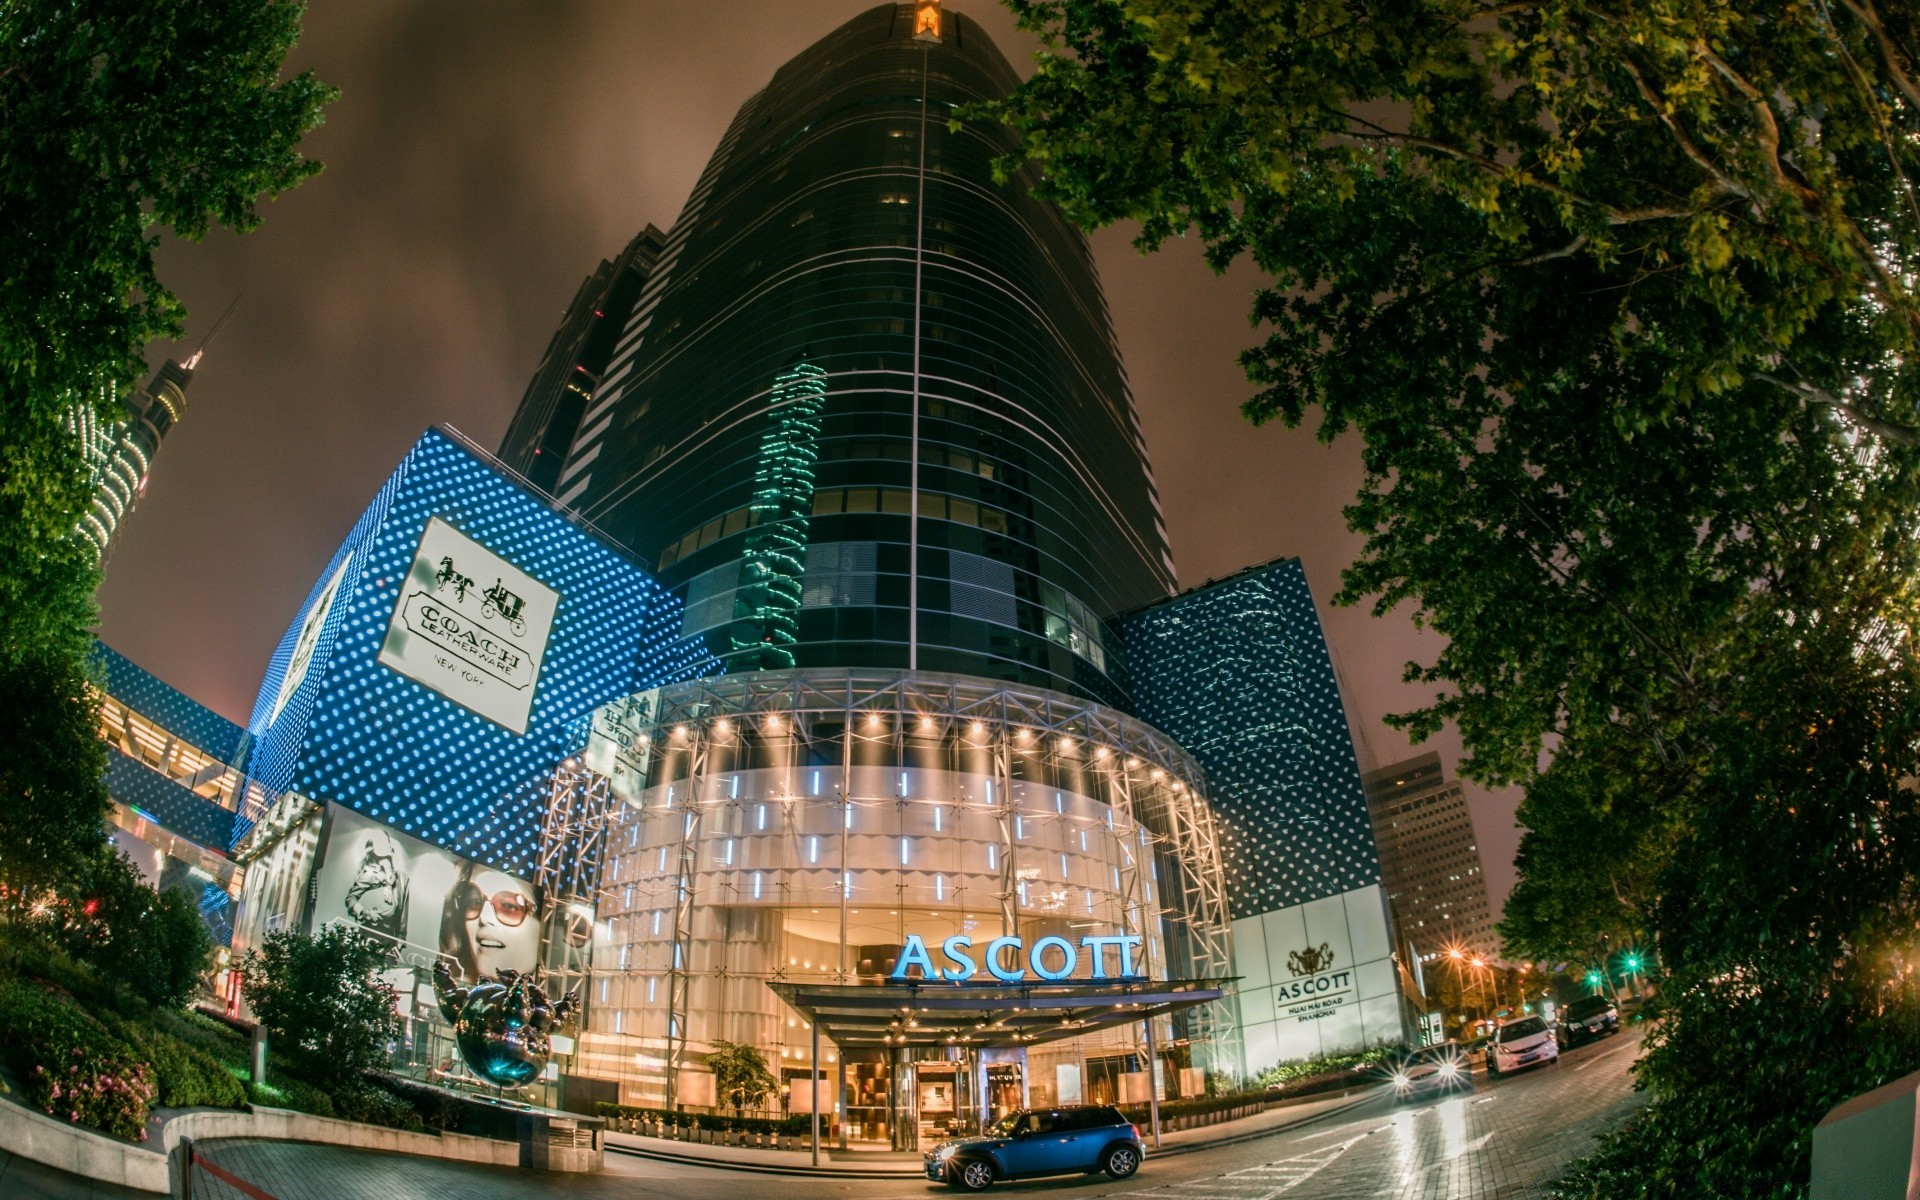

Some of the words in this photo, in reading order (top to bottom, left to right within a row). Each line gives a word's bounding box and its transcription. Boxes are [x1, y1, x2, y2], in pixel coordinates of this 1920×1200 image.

[420, 605, 521, 669] COACH
[421, 619, 512, 675] LEATHERWARE
[434, 655, 458, 672] NEW
[891, 934, 1142, 981] ASCOTT
[1278, 971, 1350, 1002] ASCOTT
[1288, 1004, 1307, 1015] HUAI
[1308, 1002, 1321, 1012] HAI
[1322, 997, 1343, 1008] ROAD
[1298, 1009, 1336, 1023] SHANGHAI
